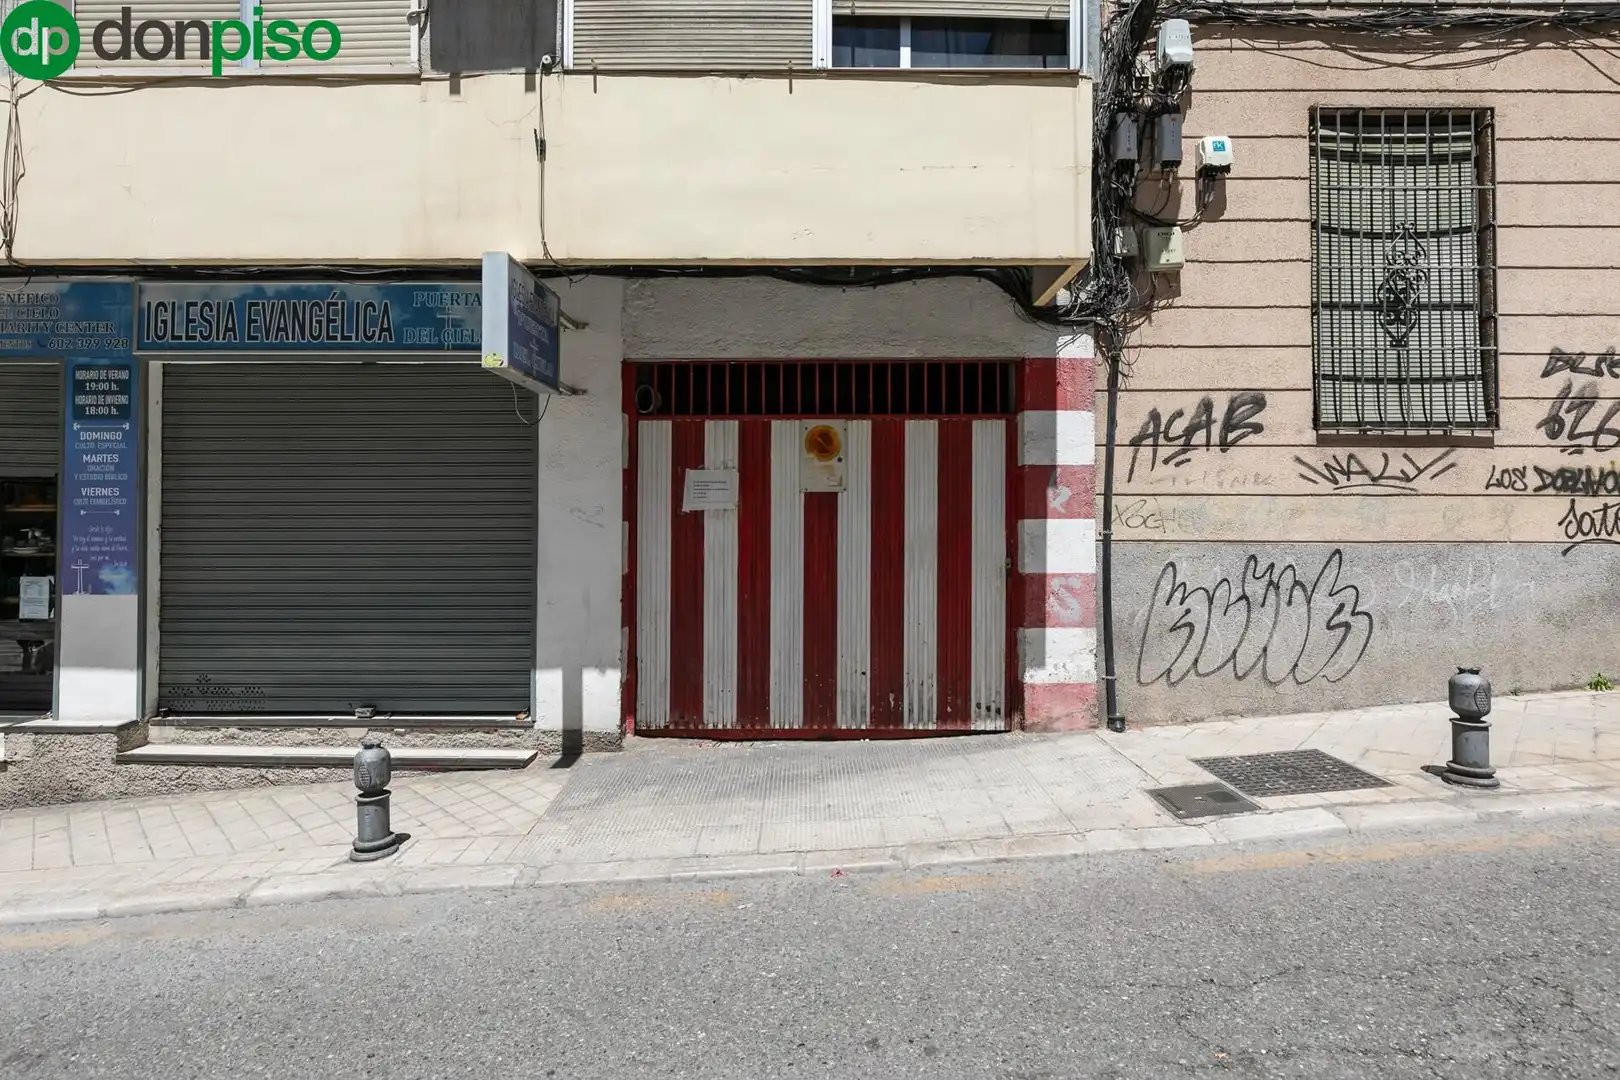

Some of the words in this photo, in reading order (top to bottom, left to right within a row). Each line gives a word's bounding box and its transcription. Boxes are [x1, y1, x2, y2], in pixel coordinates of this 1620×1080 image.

[413, 291, 482, 307] PUERTA
[17, 307, 60, 319] CIELO
[145, 300, 240, 342] IGLESIA
[245, 290, 395, 343] EVANGÉLICA
[55, 321, 116, 334] CENTER
[403, 328, 438, 344] DEL
[441, 328, 482, 344] CIEL
[48, 338, 73, 349] 602
[76, 338, 101, 349] 399
[104, 338, 130, 349] 928
[75, 370, 98, 380] HORARIO
[100, 370, 107, 380] DE
[108, 370, 130, 380] VERANO
[85, 382, 109, 391] 19:00
[75, 395, 97, 404] HORARIO
[98, 395, 105, 404] DE
[105, 395, 129, 404] INVIERNO
[85, 406, 109, 415] 18:00
[80, 431, 122, 440] DOMINGO
[1127, 392, 1267, 483] ACAB
[82, 454, 119, 463] MARTES
[1485, 465, 1527, 491] LOS
[81, 487, 120, 496] VIERNES
